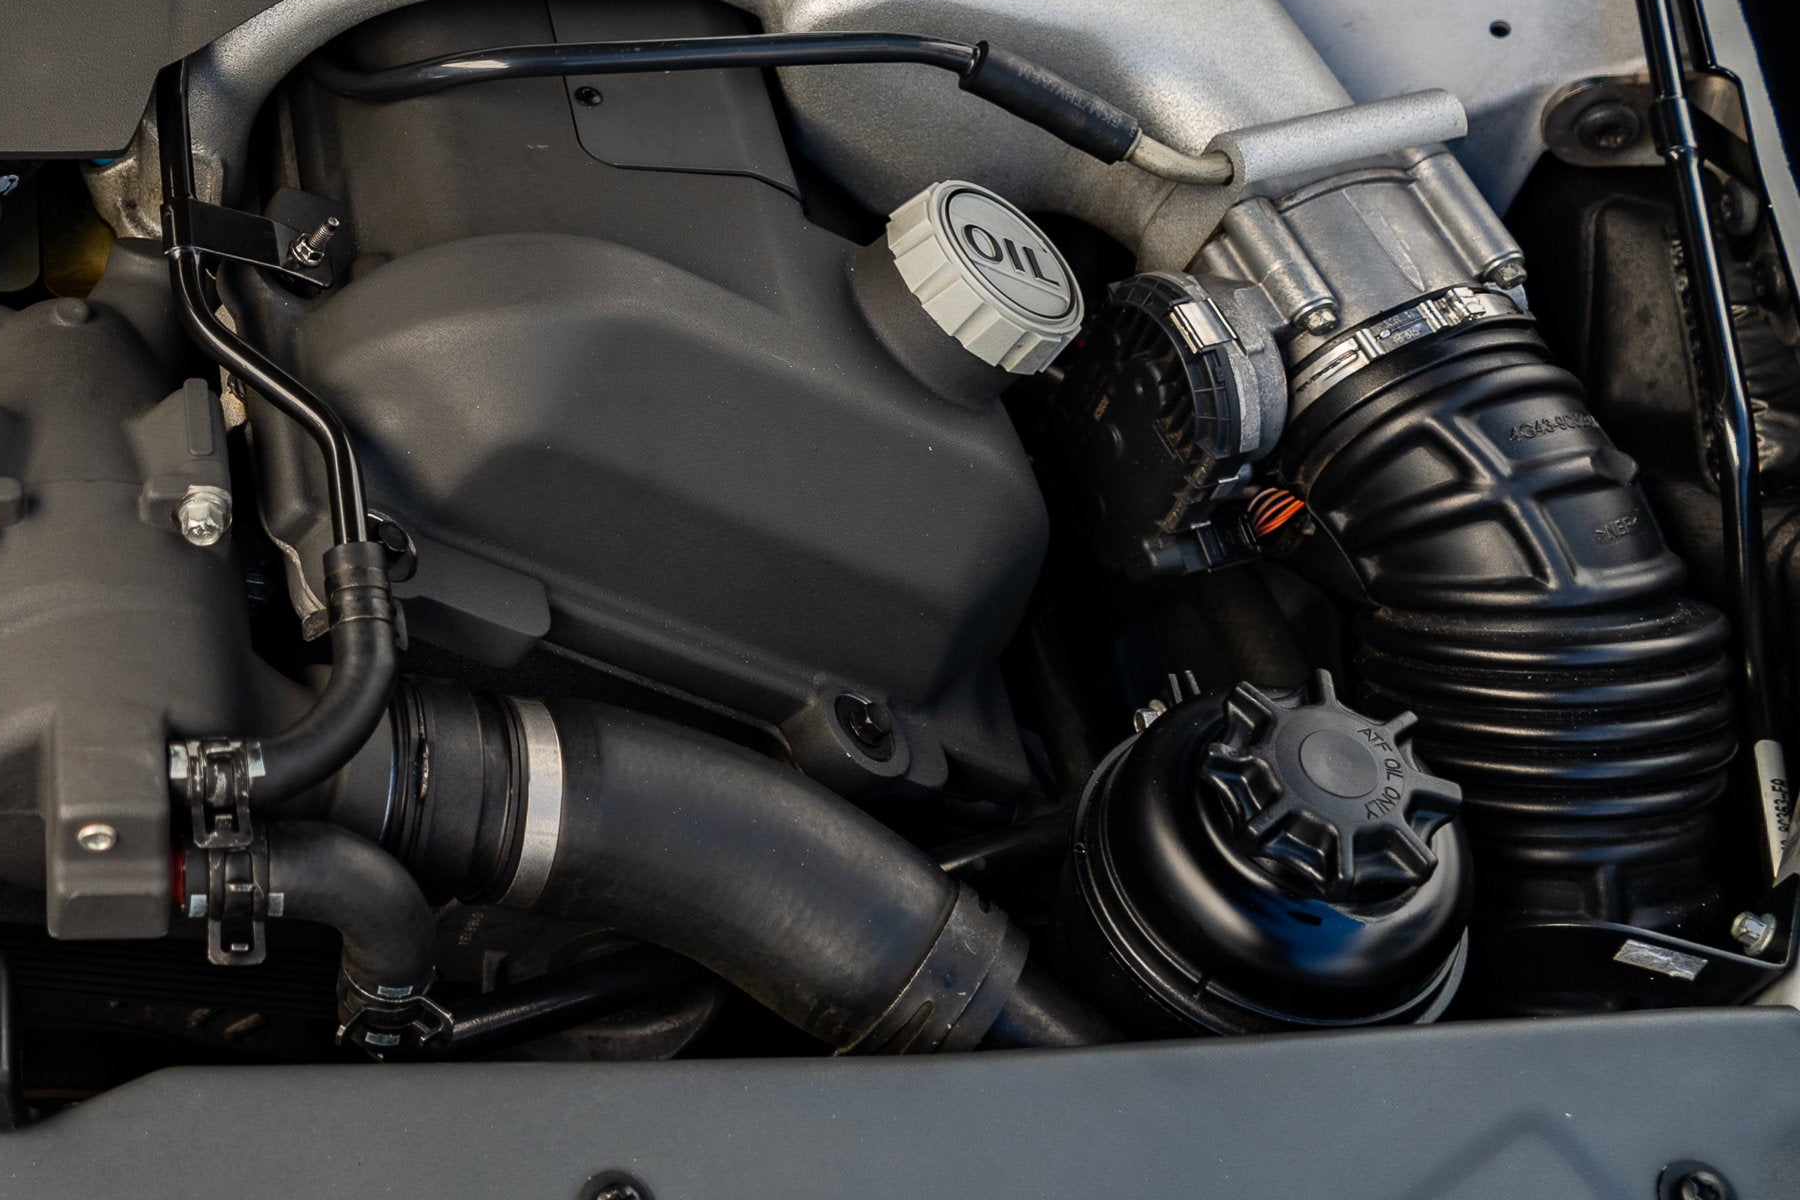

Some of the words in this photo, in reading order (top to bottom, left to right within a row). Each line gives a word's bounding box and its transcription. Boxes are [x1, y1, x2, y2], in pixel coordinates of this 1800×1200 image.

[961, 224, 1061, 288] OIL
[1357, 728, 1393, 752] ATF
[1384, 758, 1404, 781] OIL
[1364, 786, 1400, 820] ONLY
